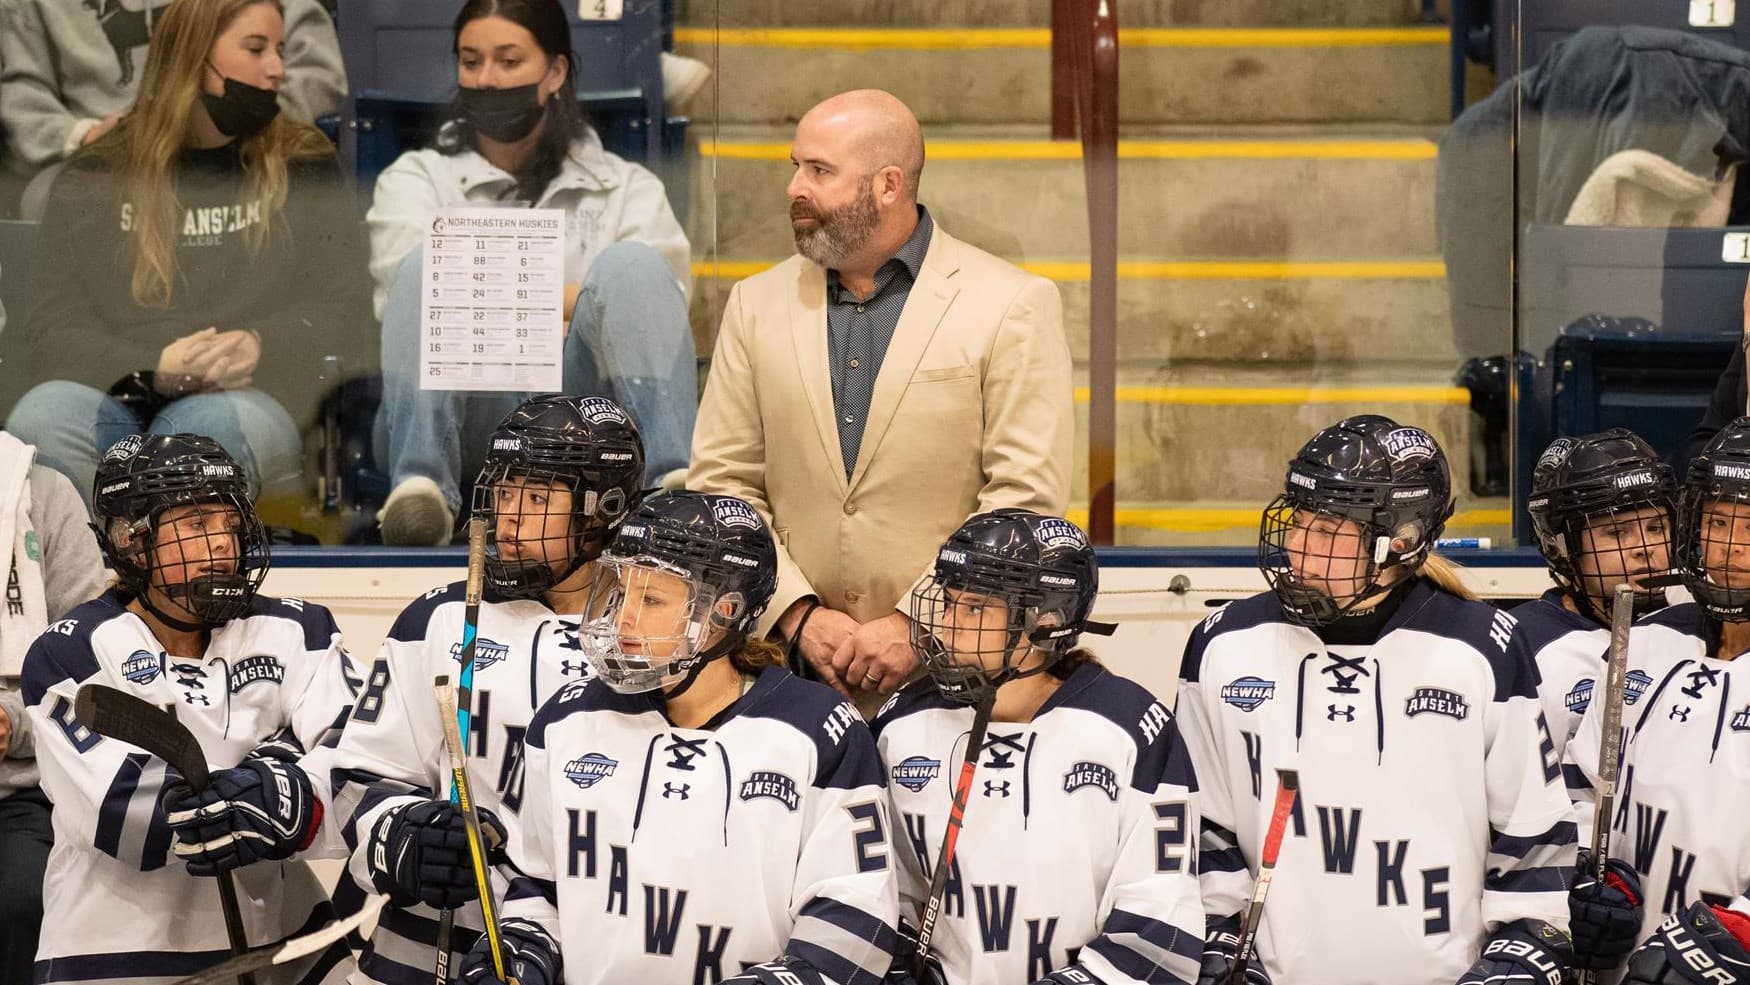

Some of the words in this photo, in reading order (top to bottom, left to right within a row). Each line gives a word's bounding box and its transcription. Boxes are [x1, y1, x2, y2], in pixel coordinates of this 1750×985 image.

[447, 217, 517, 228] NORTHEASTERN
[518, 219, 559, 229] HUSKIES
[432, 240, 442, 249] 12
[476, 241, 485, 249] 11
[518, 242, 528, 250] 21
[432, 256, 442, 265] 17
[473, 273, 485, 281] 42
[518, 274, 528, 282] 15
[433, 289, 439, 297] 5
[473, 290, 484, 298] 24
[517, 290, 527, 299] 91
[430, 312, 441, 320] 27
[473, 312, 484, 320] 22
[516, 313, 527, 321] 37
[430, 327, 441, 336] 10
[516, 329, 527, 337] 33
[473, 344, 484, 353] 19
[519, 345, 524, 353] 1
[430, 368, 441, 376] 25
[494, 438, 521, 451] HAWKS
[202, 464, 234, 477] HAWKS
[1714, 464, 1750, 479] HAWKS
[1290, 473, 1316, 490] HAWKS
[1617, 472, 1652, 489] HAWKS
[620, 525, 646, 538] HAWKS
[940, 549, 966, 564] HAWKS
[451, 644, 507, 661] NWHA
[122, 658, 157, 675] NEWH
[231, 665, 283, 691] ANSELM
[1221, 686, 1274, 700] NEWHA
[1418, 690, 1459, 701] SAINT
[1566, 690, 1590, 706] NEW
[1408, 697, 1465, 717] ANSELM
[565, 761, 615, 777] NEWHA
[892, 766, 940, 778] NEWHA
[754, 773, 793, 788] SAINT
[1066, 771, 1117, 799] ANSELM
[742, 782, 798, 808] ANSELM
[565, 807, 765, 985] HAWK
[916, 896, 939, 957] BAUER
[1661, 915, 1737, 985] AUER
[436, 950, 448, 985] BAU
[1483, 938, 1562, 985] BAUE
